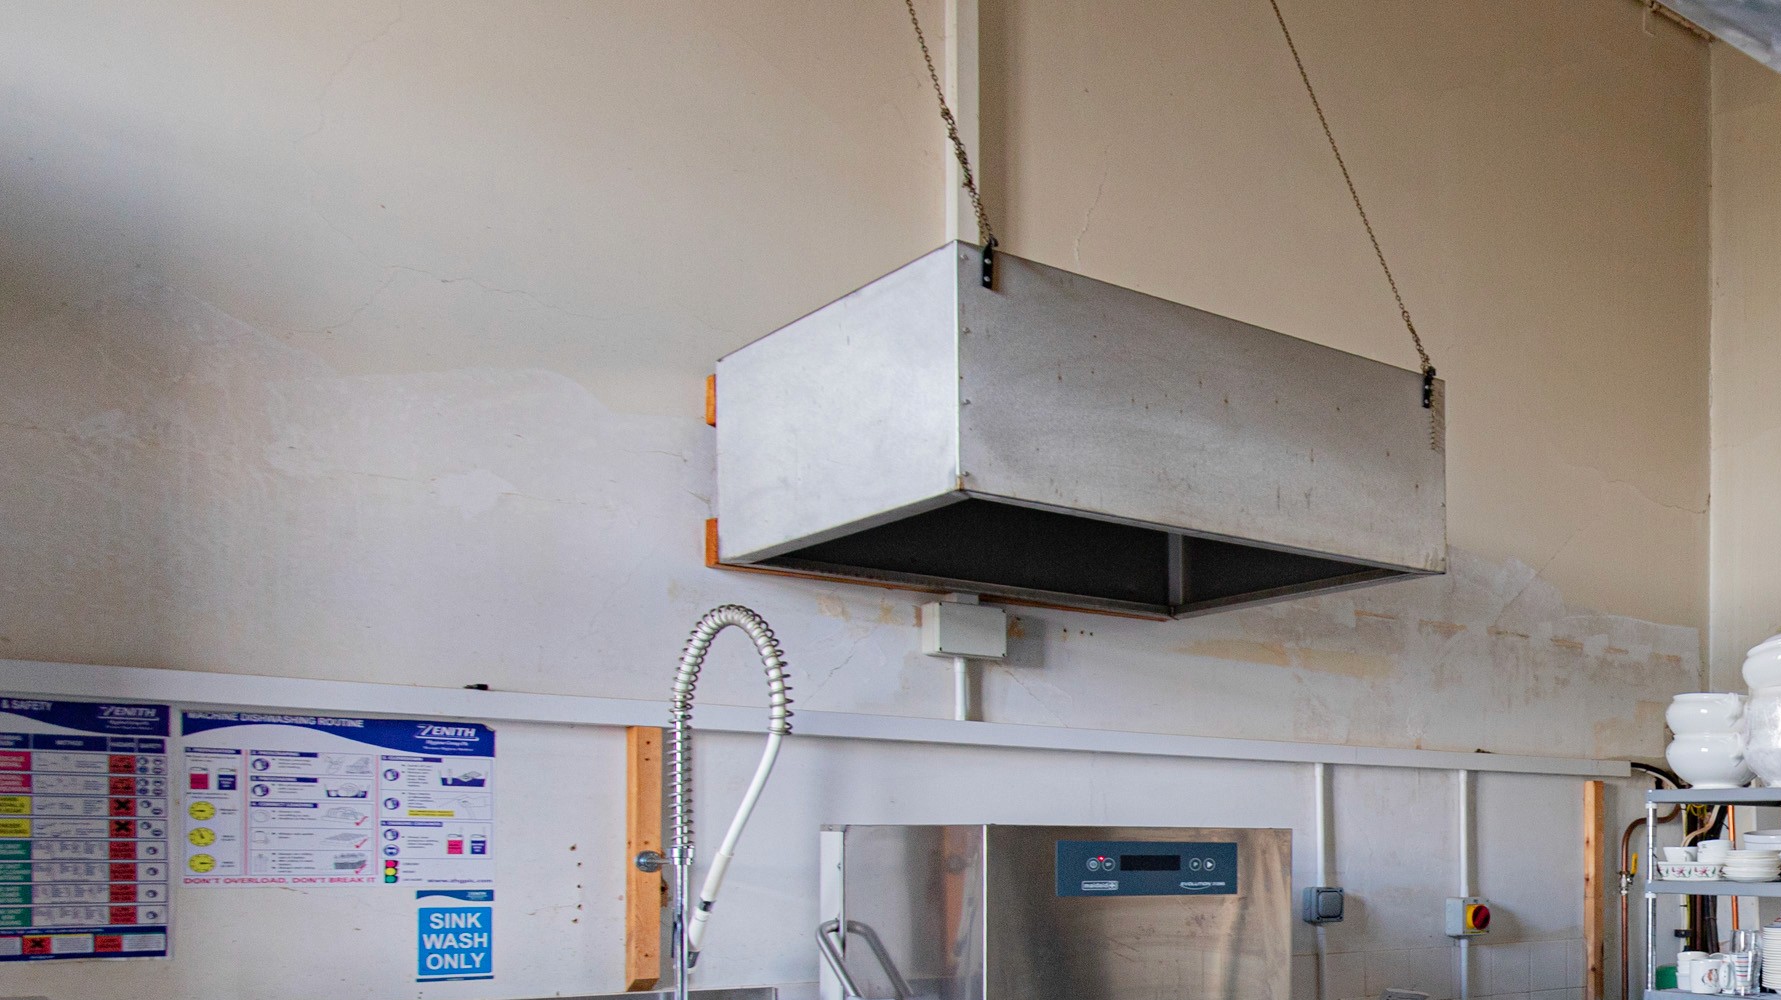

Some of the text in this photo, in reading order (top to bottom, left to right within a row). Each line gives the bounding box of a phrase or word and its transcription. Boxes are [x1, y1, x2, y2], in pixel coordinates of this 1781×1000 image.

[11, 699, 53, 711] SAFETY
[240, 713, 317, 725] DISHWASHING
[317, 717, 365, 728] ROUTINE
[416, 724, 477, 737] ZENITH
[429, 912, 483, 930] SINK
[422, 932, 488, 950] WASH
[425, 952, 486, 970] ONLY
